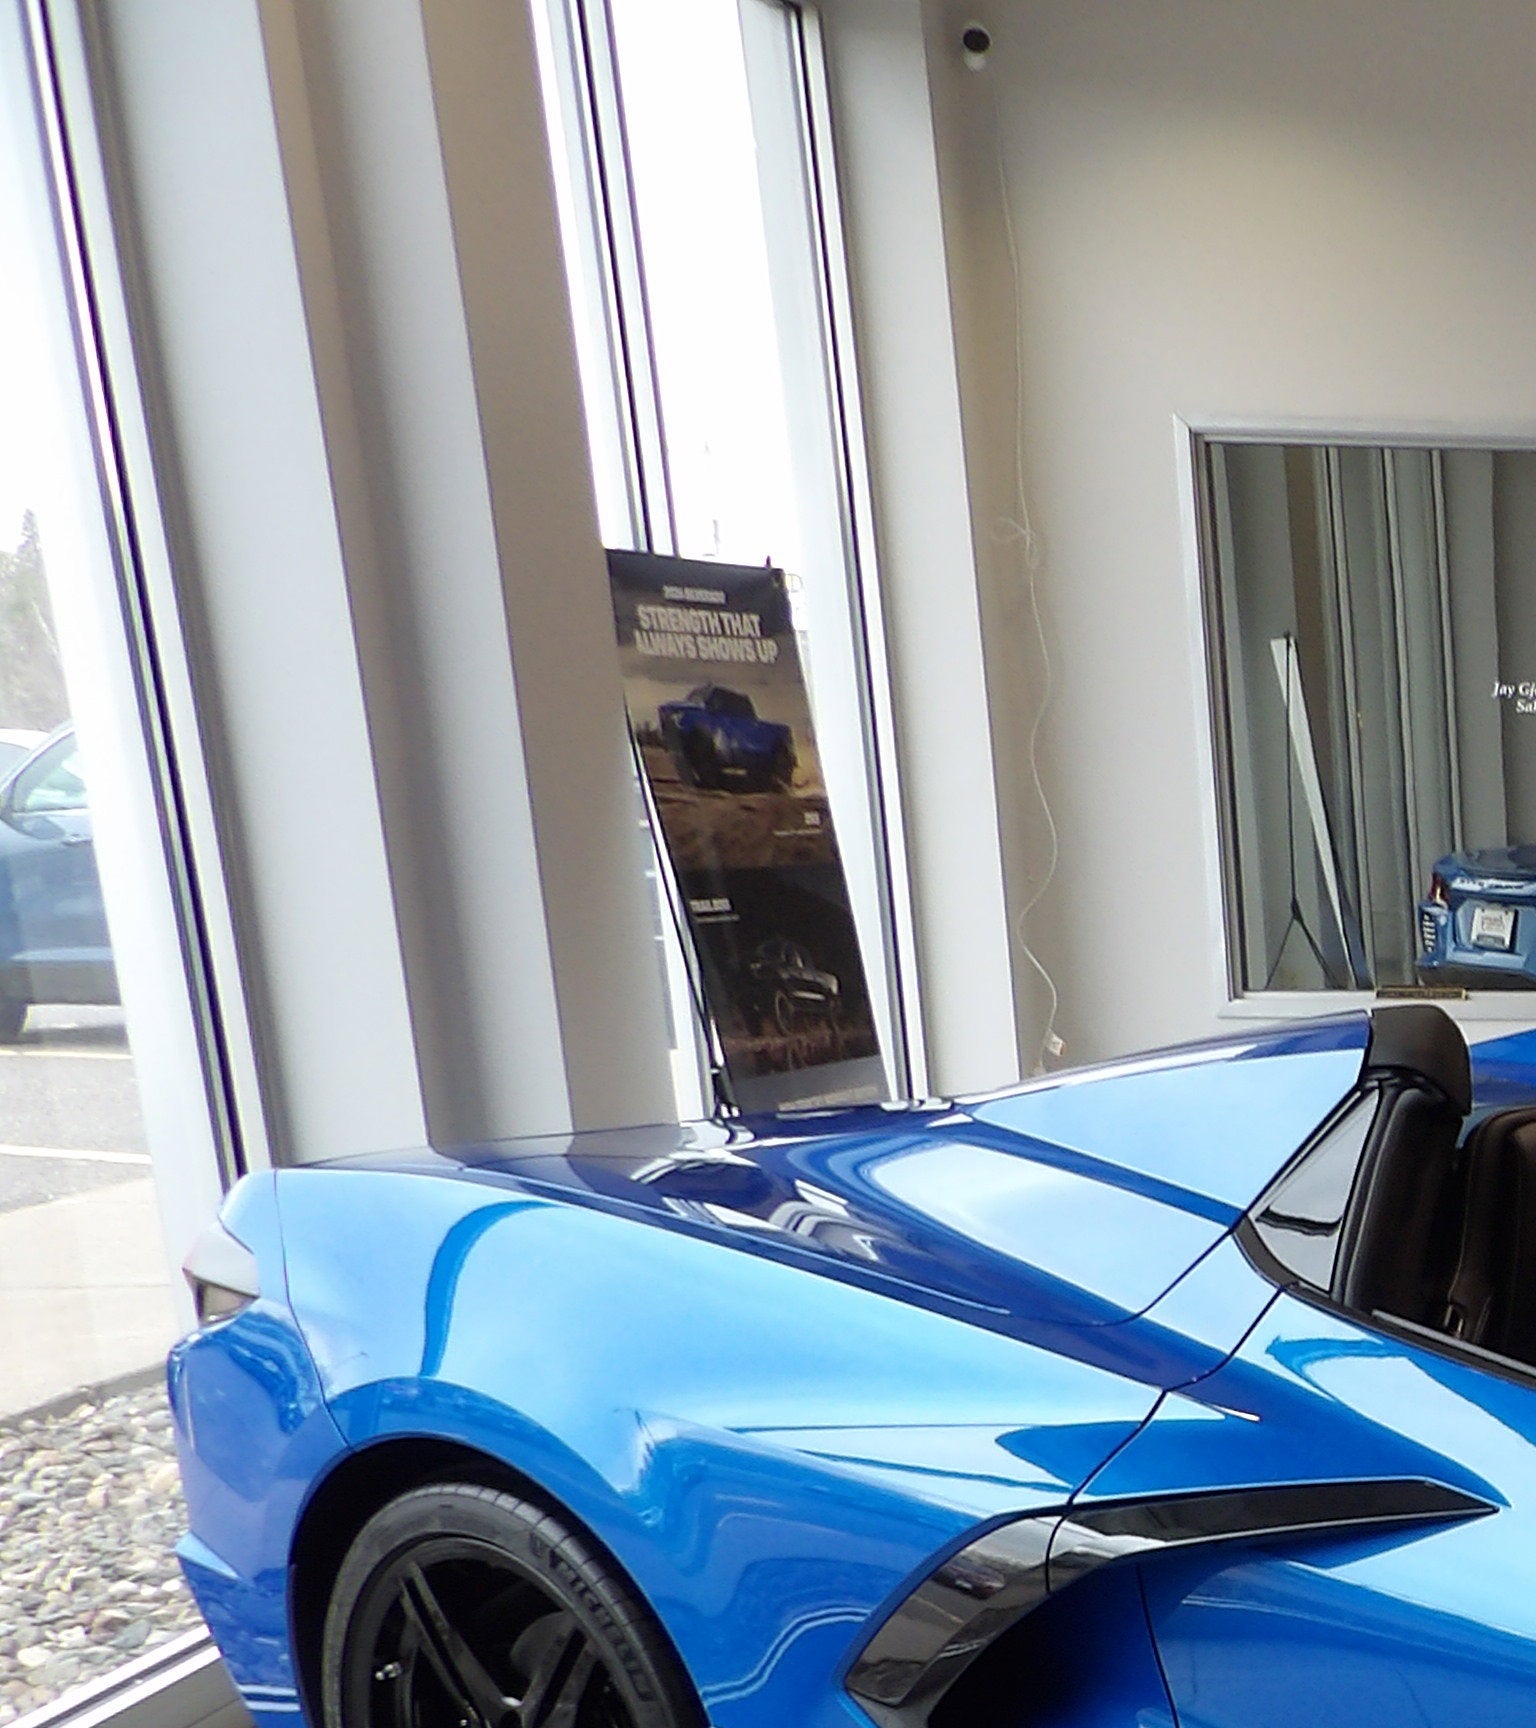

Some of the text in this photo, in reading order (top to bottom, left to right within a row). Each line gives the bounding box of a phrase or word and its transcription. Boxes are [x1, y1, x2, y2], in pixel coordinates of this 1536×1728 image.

[637, 604, 761, 638] STRENGTH THAT
[633, 629, 779, 664] ALWAYS SHOWS UP
[1491, 680, 1516, 699] Jay
